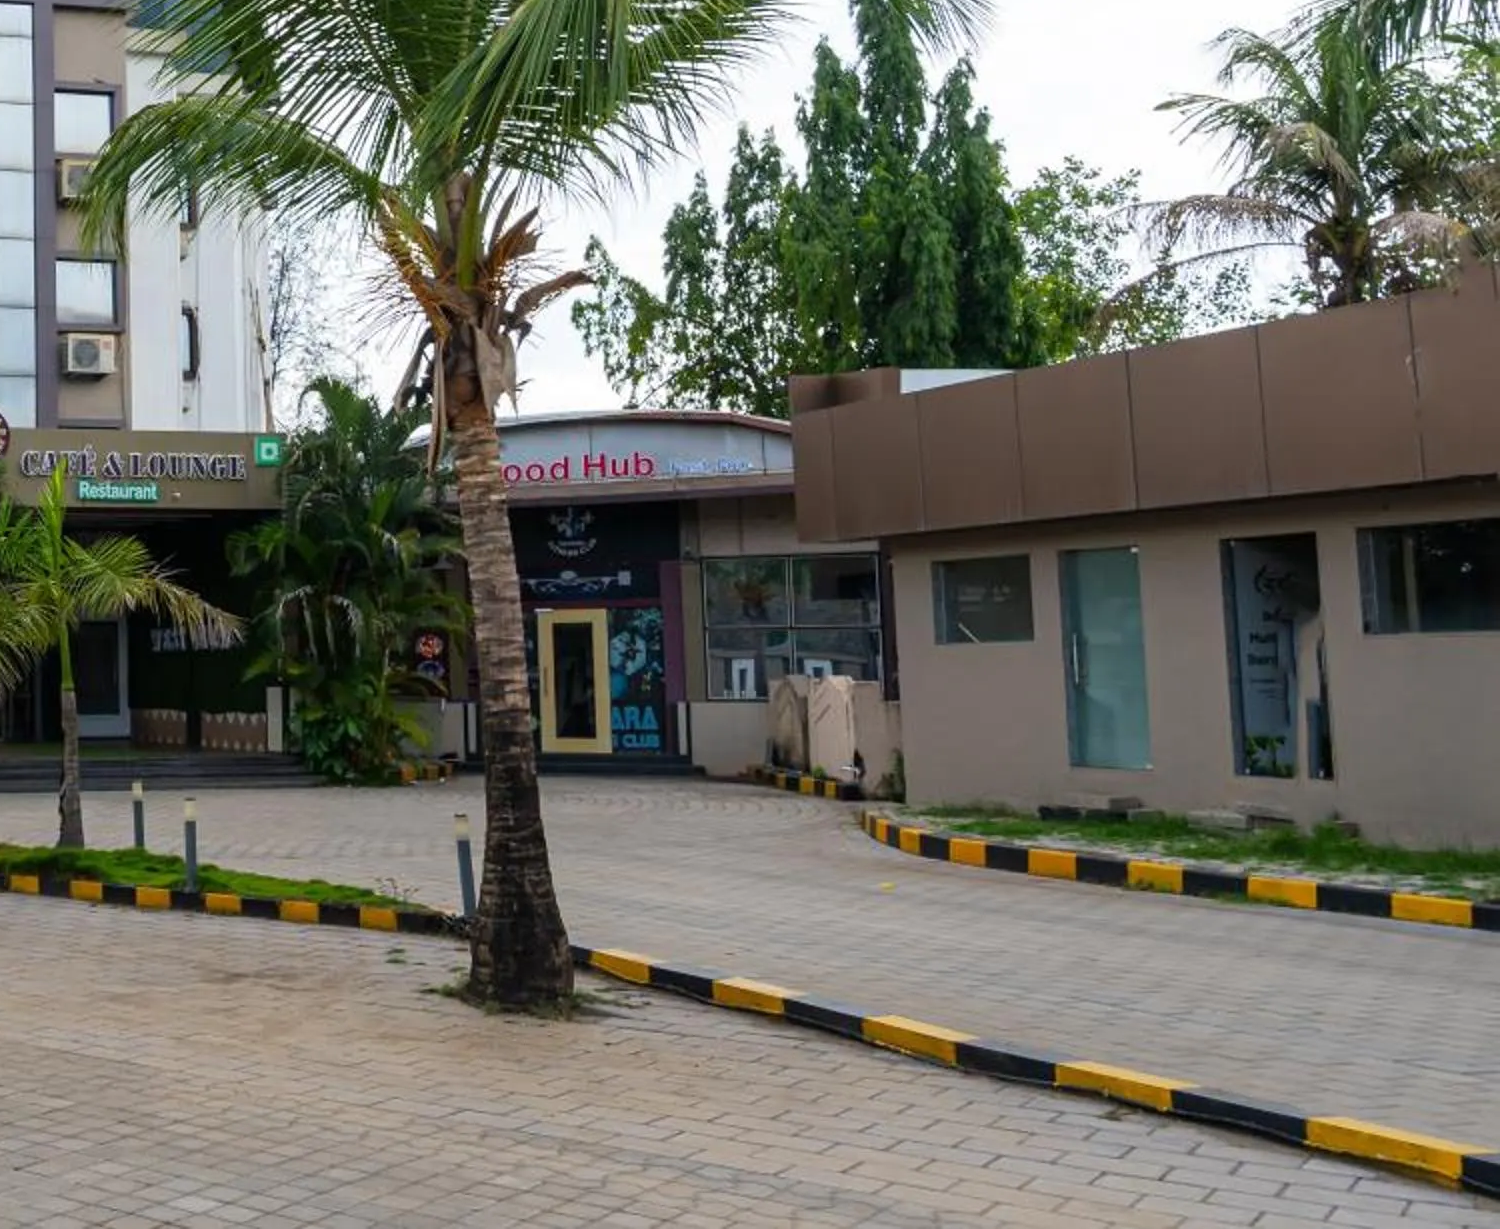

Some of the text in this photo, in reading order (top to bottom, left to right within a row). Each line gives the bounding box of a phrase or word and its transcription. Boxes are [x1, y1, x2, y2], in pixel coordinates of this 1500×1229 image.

[102, 452, 126, 479] &
[129, 452, 247, 481] LOUNGE
[502, 456, 569, 484] ood
[583, 451, 655, 479] Hub
[79, 480, 158, 500] Restaurant
[612, 705, 659, 730] ARA
